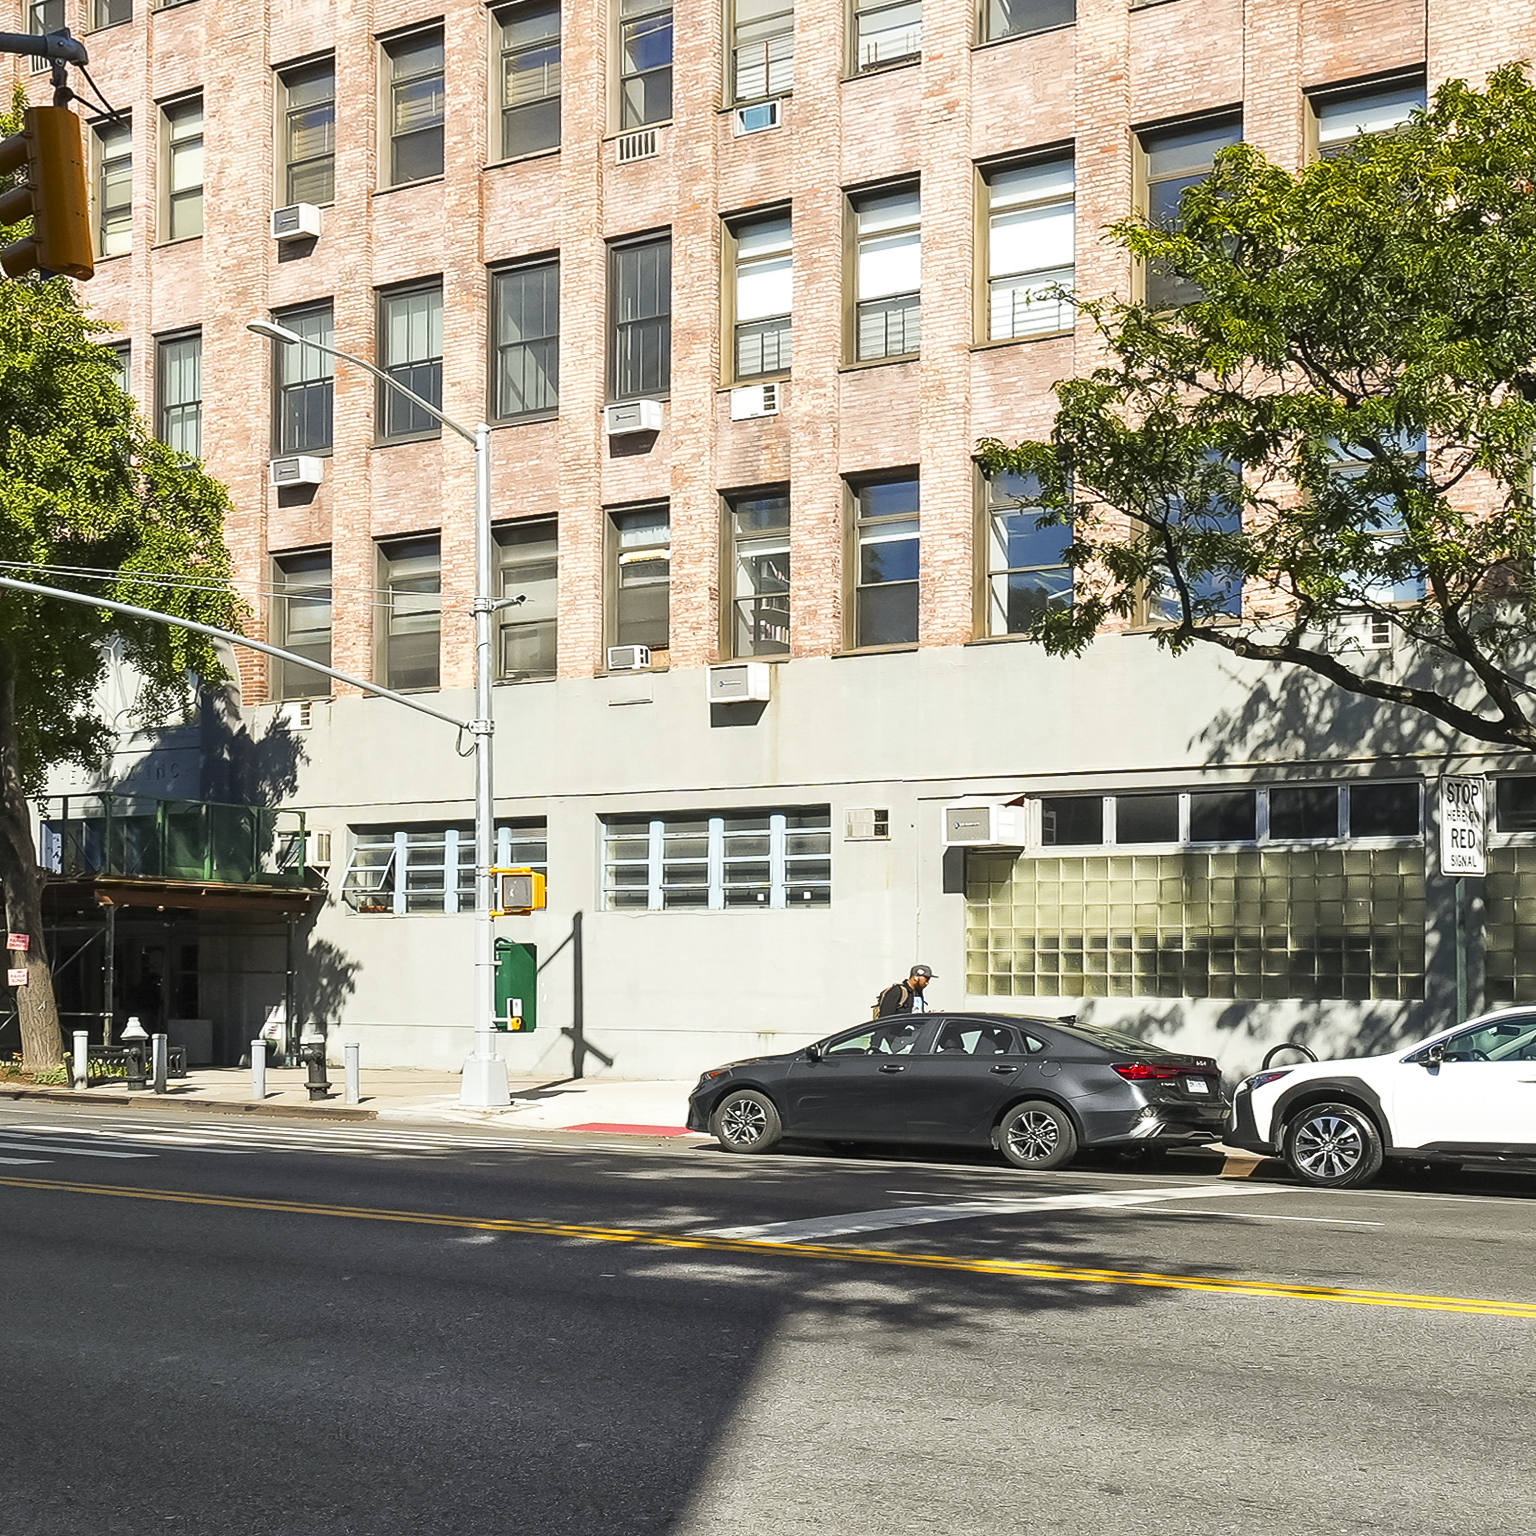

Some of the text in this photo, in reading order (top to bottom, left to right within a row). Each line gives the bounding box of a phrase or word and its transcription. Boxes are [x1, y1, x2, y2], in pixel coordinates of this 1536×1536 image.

[1446, 781, 1479, 805] STOP
[1446, 809, 1467, 822] HERE
[1450, 827, 1476, 849] RED
[1450, 854, 1477, 868] SIGNAL
